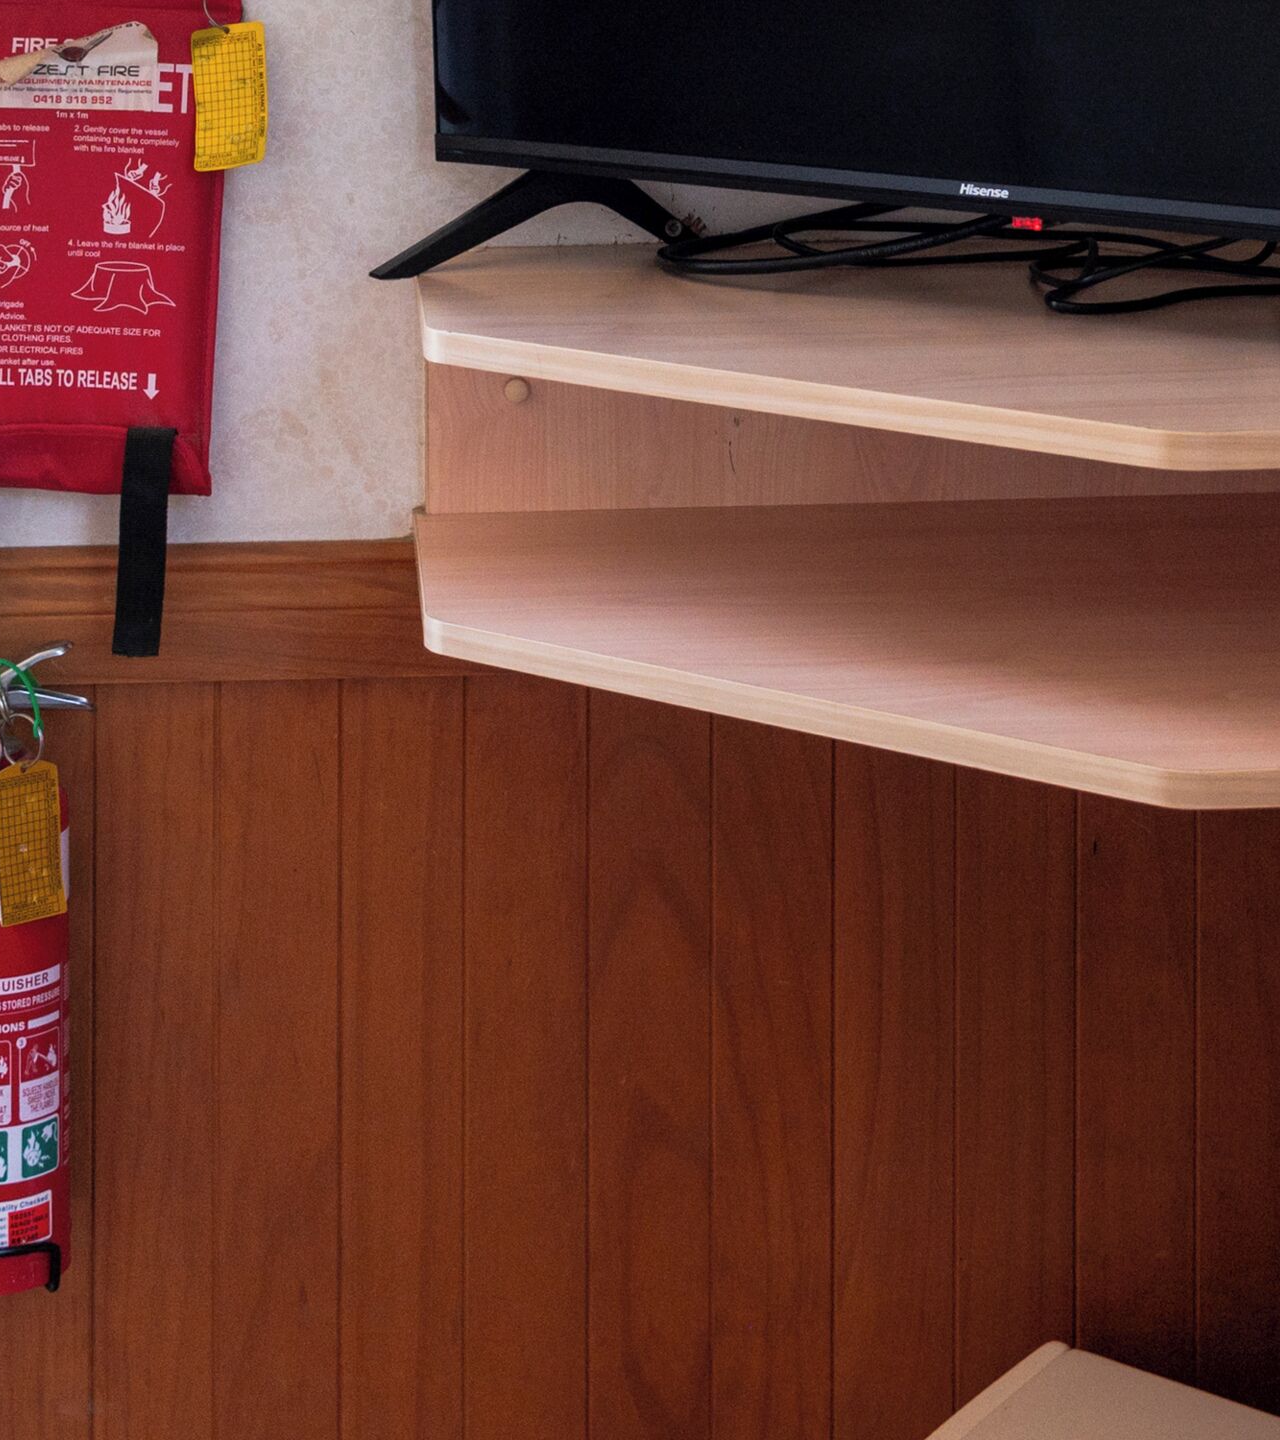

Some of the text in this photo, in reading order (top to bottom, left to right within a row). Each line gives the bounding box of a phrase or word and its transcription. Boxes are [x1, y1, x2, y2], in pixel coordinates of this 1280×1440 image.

[97, 65, 140, 77] FIRE
[78, 79, 152, 87] MAINTENANCE
[33, 95, 62, 104] 0418
[91, 96, 113, 105] 952
[83, 125, 107, 135] Gently
[108, 127, 129, 135] cover
[131, 127, 143, 135] the
[144, 128, 168, 136] vessel
[73, 134, 111, 144] containing
[113, 136, 124, 144] the
[140, 138, 179, 148] completely
[74, 144, 89, 152] with
[104, 145, 116, 153] fire
[117, 145, 144, 154] blanket
[960, 183, 1009, 199] Hisense
[23, 224, 31, 232] of
[32, 224, 49, 232] heat
[77, 239, 99, 248] Leave
[101, 240, 113, 248] the
[115, 241, 127, 249] fire
[128, 242, 156, 250] blanket
[157, 243, 164, 251] in
[166, 243, 186, 252] place
[68, 249, 83, 257] until
[0, 312, 26, 320] Advice.
[44, 325, 61, 333] NOT
[63, 325, 75, 333] OF
[76, 326, 121, 335] ADEQUATE
[122, 328, 141, 336] SIZE
[143, 329, 161, 337] FOR
[1, 334, 44, 342] CLOTHING
[10, 346, 58, 354] ELECTRICAL
[60, 347, 84, 355] FIRES
[22, 358, 39, 366] after
[18, 368, 52, 386] TABS
[56, 369, 74, 387] TO
[77, 370, 138, 390] RELEASE
[2, 997, 31, 1010] STORED
[32, 987, 60, 1005] PRESSURE
[19, 1194, 49, 1208] Checked
